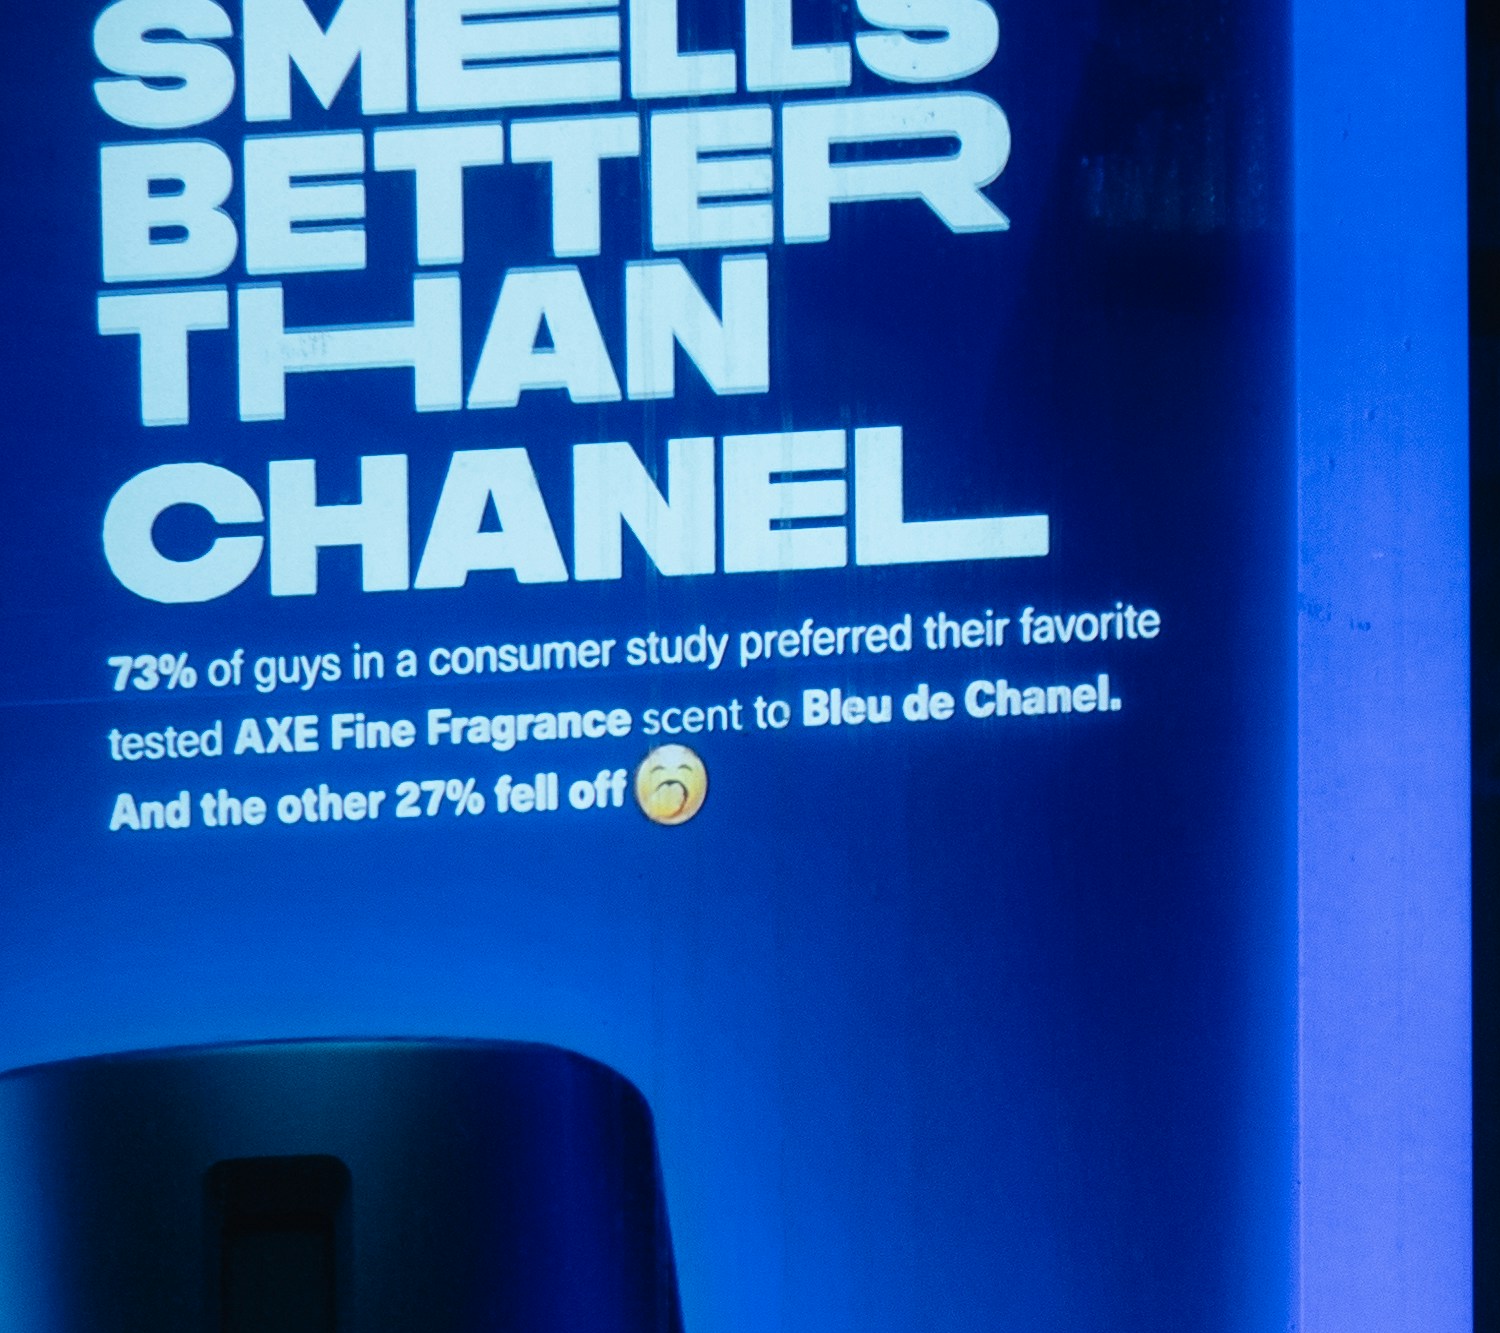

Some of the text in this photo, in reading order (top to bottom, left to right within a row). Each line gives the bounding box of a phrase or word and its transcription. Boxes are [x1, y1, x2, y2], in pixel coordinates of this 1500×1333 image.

[91, 0, 1001, 129] SMELLS
[98, 89, 1013, 284] BETTER
[96, 252, 771, 427] THAN
[101, 424, 1050, 604] CHANEL
[107, 602, 1162, 694] 73% of guys in a consumer study preferred their favorite
[108, 672, 1123, 761] tested AXE Fine Fragrance scent to Bleu de Chanel.
[108, 768, 628, 832] And the other 27% fell off
